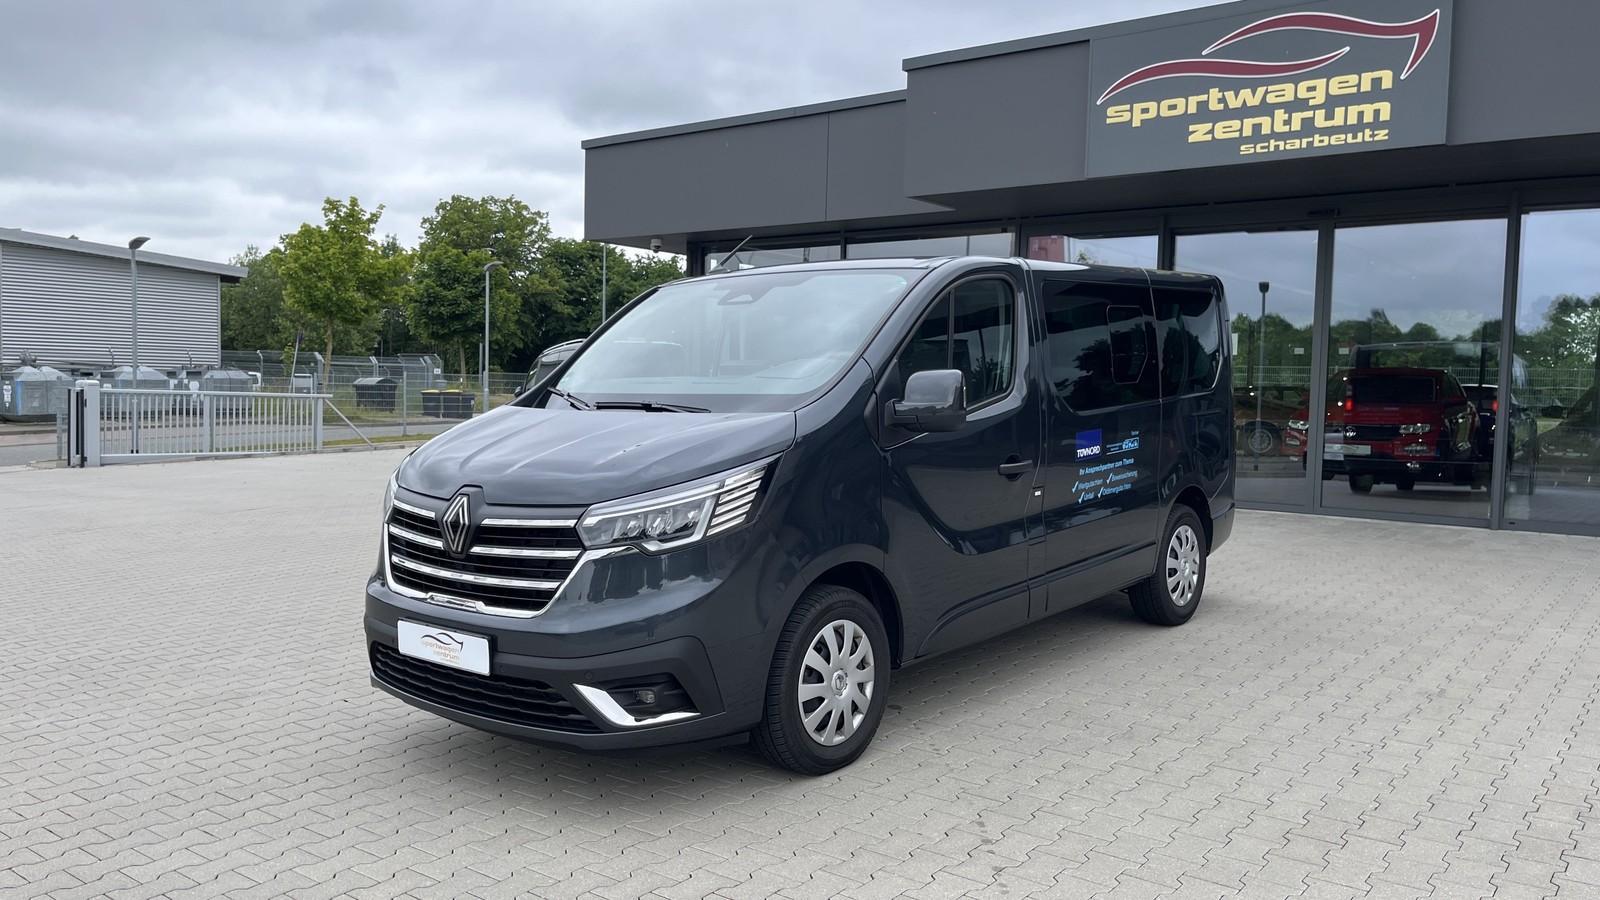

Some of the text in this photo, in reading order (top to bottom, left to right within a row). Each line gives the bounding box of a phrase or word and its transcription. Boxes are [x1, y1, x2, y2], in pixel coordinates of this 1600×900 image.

[1106, 69, 1393, 127] sportwagen
[1188, 101, 1391, 143] zentrum
[1239, 129, 1390, 154] scharbeutz
